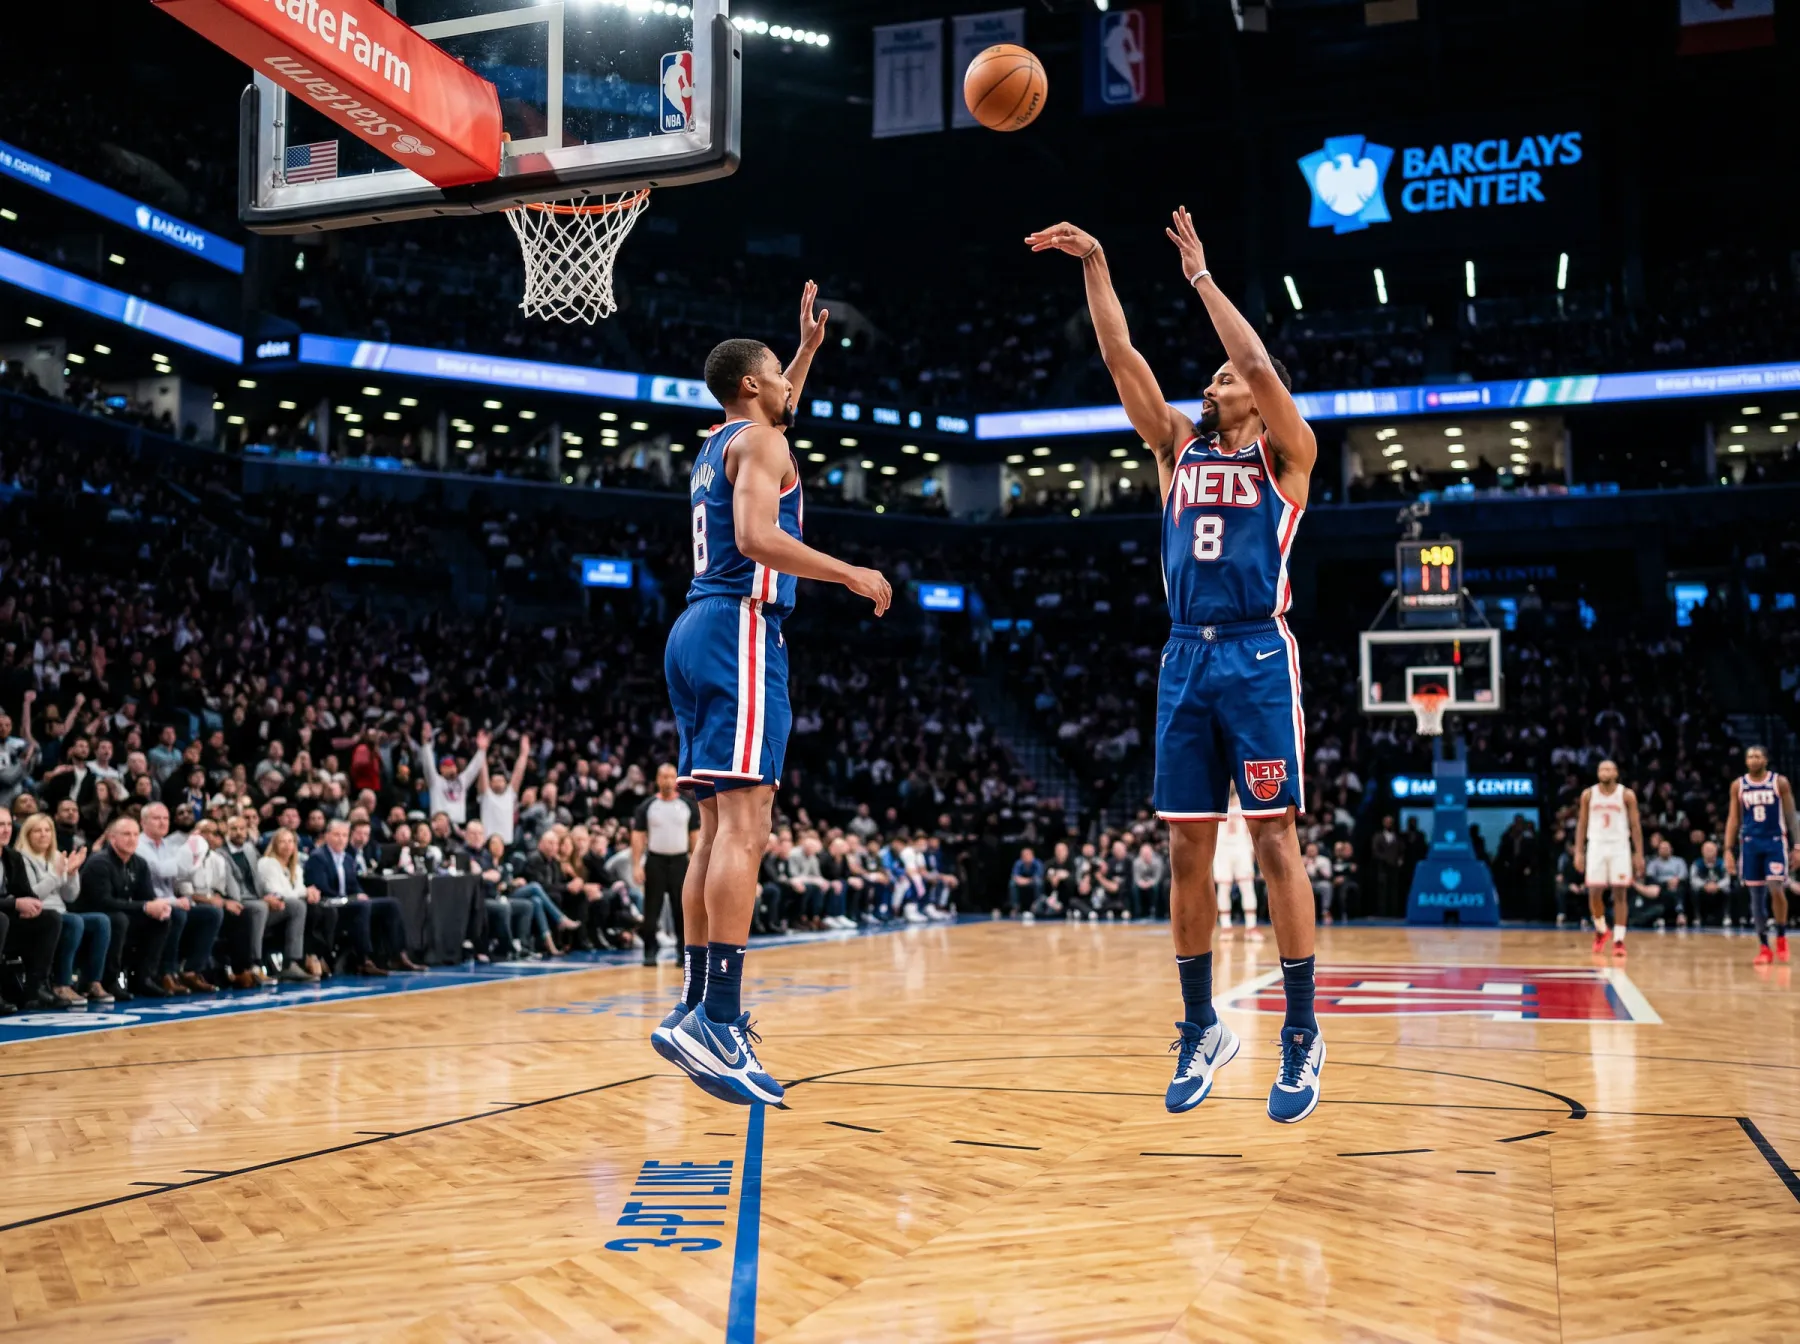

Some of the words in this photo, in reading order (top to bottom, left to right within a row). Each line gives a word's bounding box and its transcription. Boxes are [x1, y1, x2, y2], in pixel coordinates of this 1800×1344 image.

[665, 113, 682, 128] NBA
[1402, 131, 1582, 179] BARCLAYS
[1401, 170, 1546, 213] CENTER
[152, 215, 205, 251] BARCLAYS
[1173, 462, 1263, 525] NETS
[693, 501, 708, 577] 8
[1192, 514, 1224, 562] 8
[1244, 760, 1286, 784] NETS
[1477, 778, 1534, 797] CENTER
[1417, 893, 1485, 908] BARCLAYS
[630, 1160, 734, 1196] LINE
[604, 1201, 728, 1252] 3-PT
